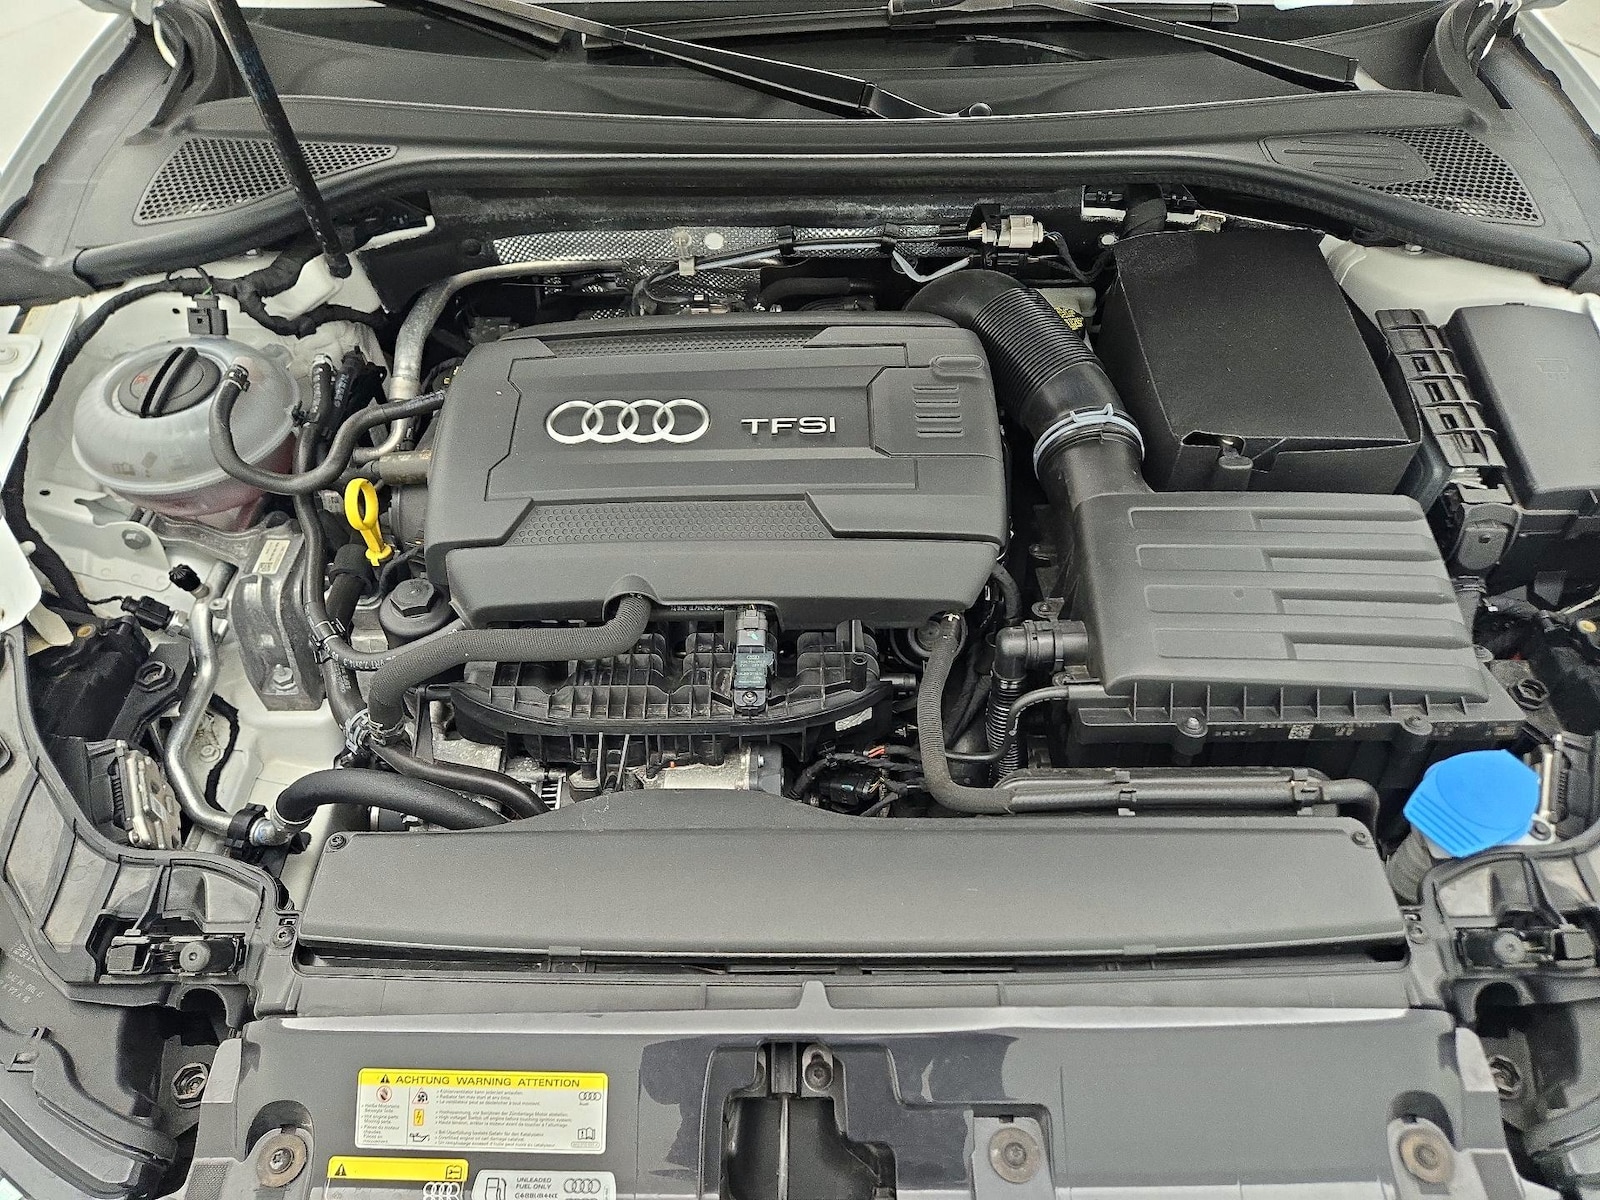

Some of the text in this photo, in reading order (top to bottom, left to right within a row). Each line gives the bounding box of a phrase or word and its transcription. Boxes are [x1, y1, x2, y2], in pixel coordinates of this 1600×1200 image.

[741, 417, 836, 434] TFSI
[396, 1075, 580, 1088] ACHTUNG WARNING ATTENTION
